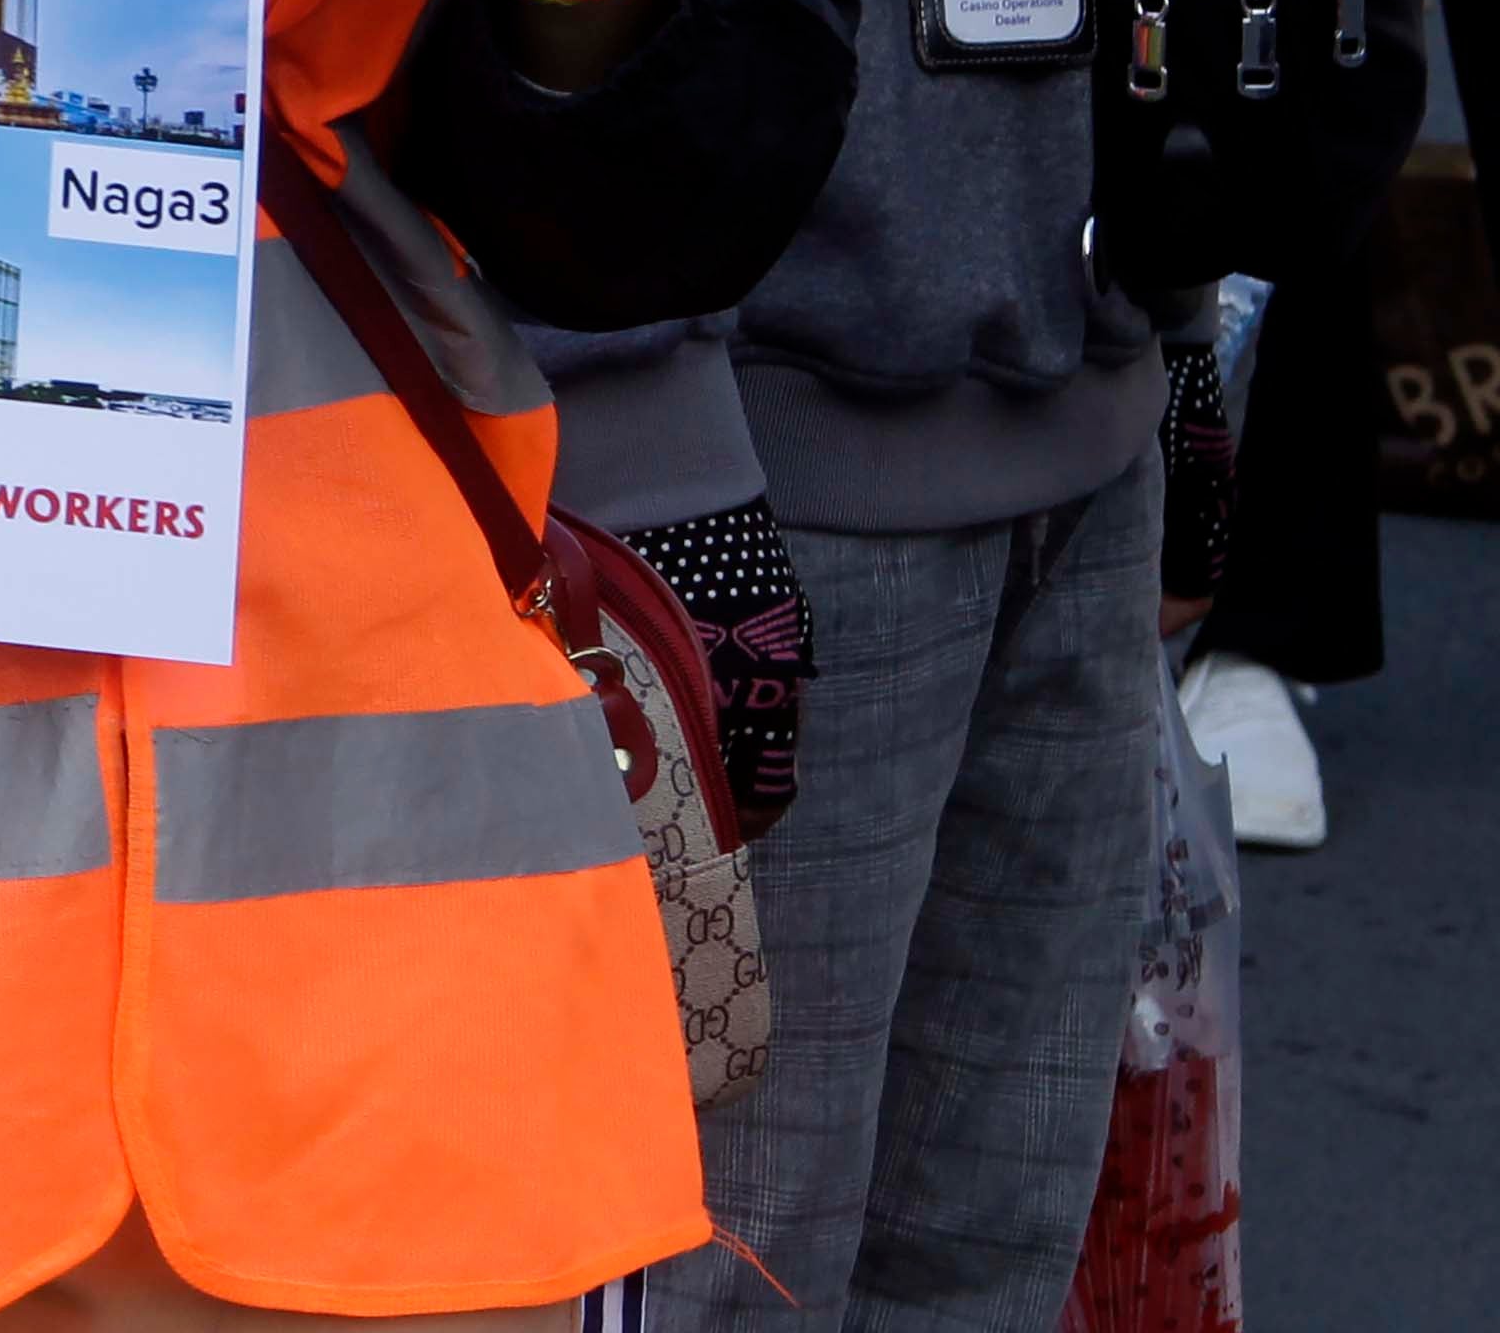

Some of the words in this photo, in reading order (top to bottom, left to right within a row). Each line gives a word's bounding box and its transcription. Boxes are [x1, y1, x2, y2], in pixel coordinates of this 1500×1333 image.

[959, 0, 1000, 13] Casino
[995, 15, 1031, 27] Dealer
[62, 167, 230, 230] Naga3
